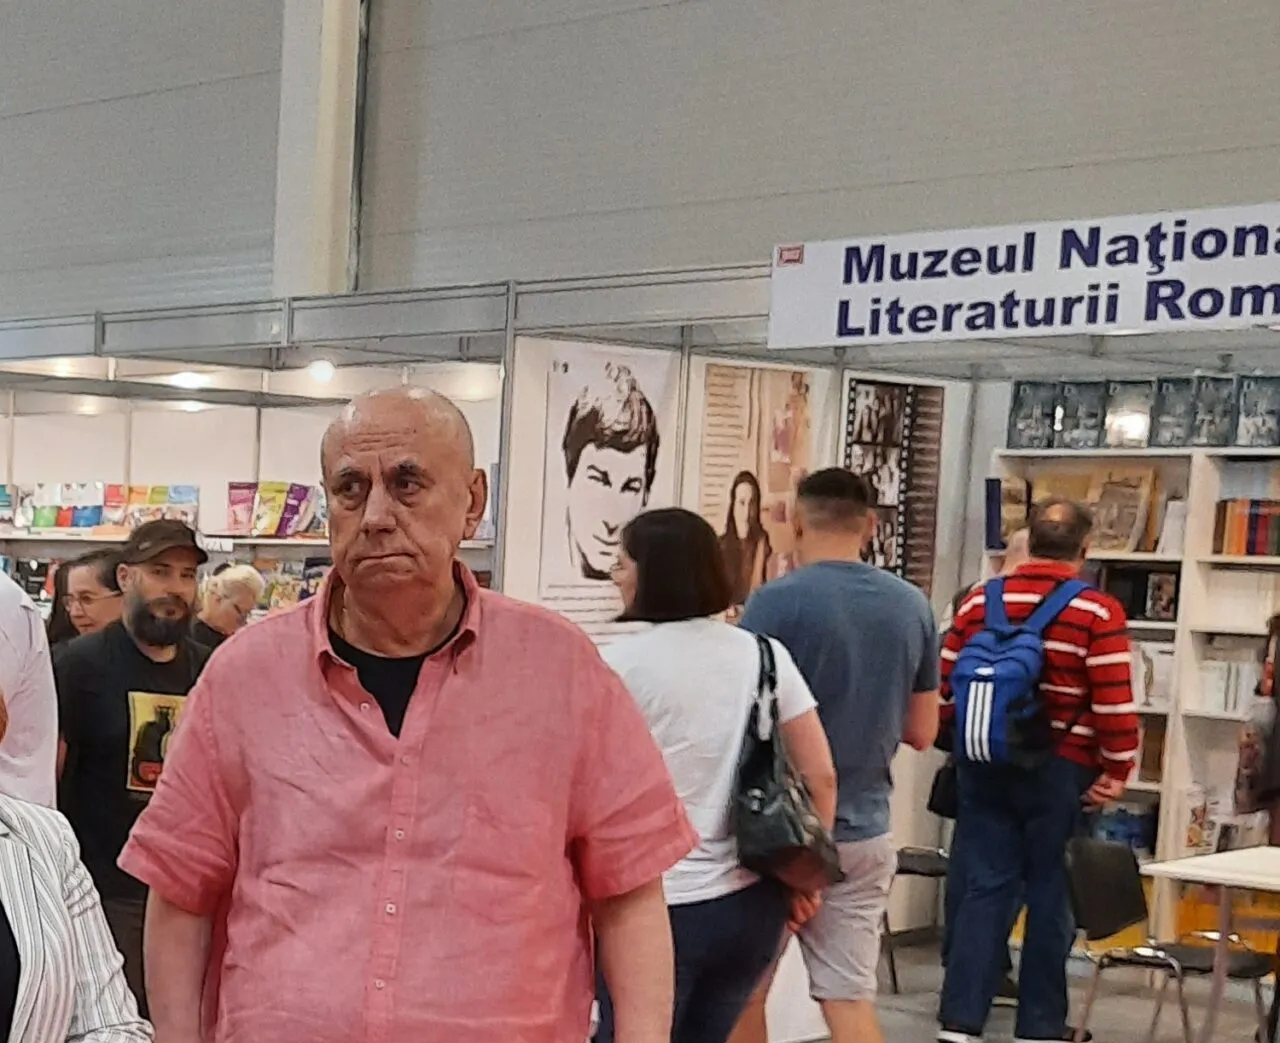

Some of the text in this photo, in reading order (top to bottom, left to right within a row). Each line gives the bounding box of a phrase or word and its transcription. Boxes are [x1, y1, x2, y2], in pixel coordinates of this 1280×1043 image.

[843, 219, 1280, 285] Muzeul Naţion
[836, 279, 1280, 337] Literaturii Rom
